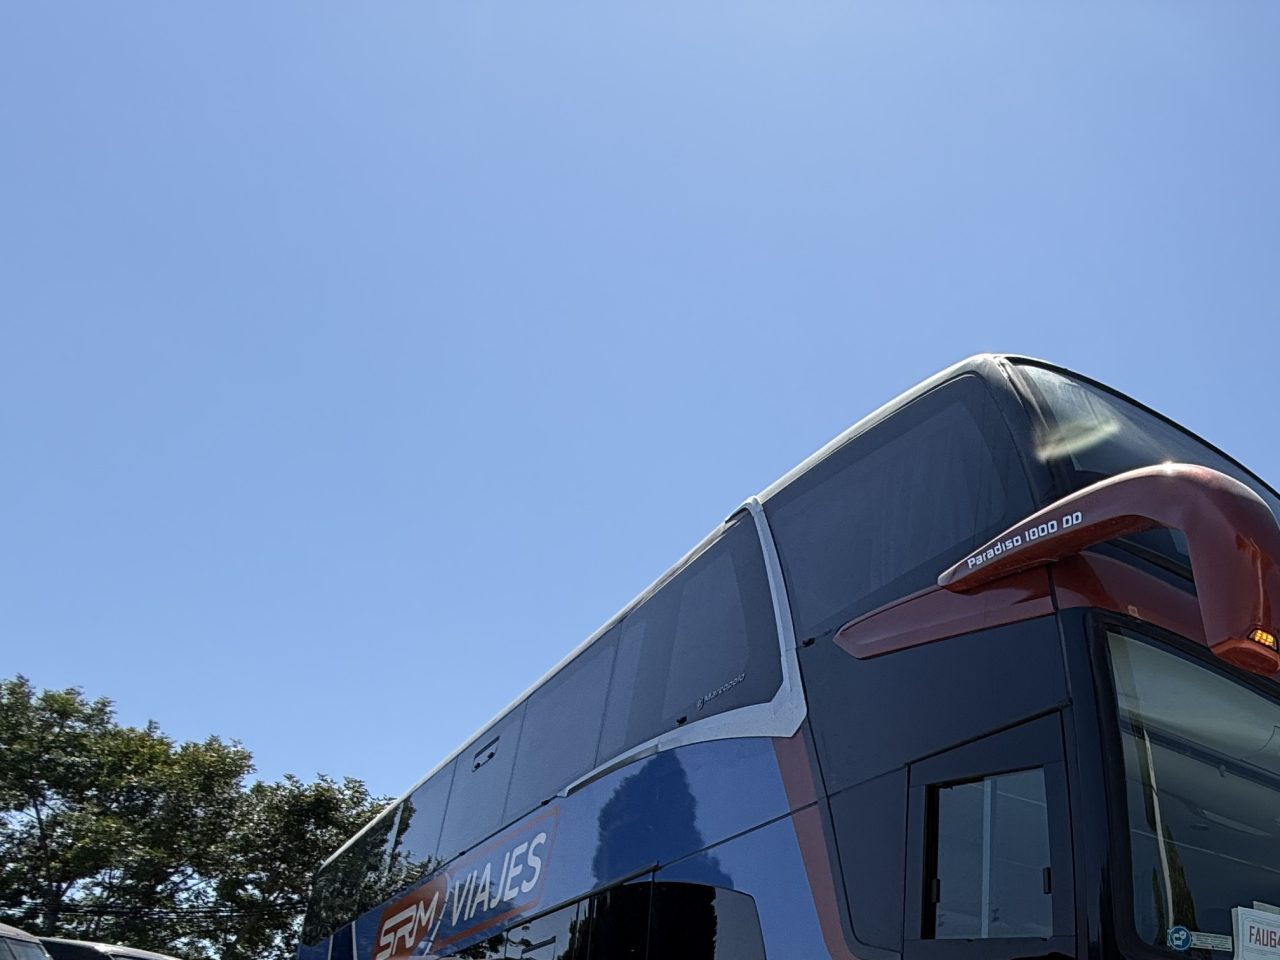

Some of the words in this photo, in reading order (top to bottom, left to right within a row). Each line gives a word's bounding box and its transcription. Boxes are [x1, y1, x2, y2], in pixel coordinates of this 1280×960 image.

[967, 536, 1022, 568] Paradiso
[1025, 520, 1058, 542] 1800
[1062, 511, 1082, 529] DD
[452, 832, 547, 927] VIAJES
